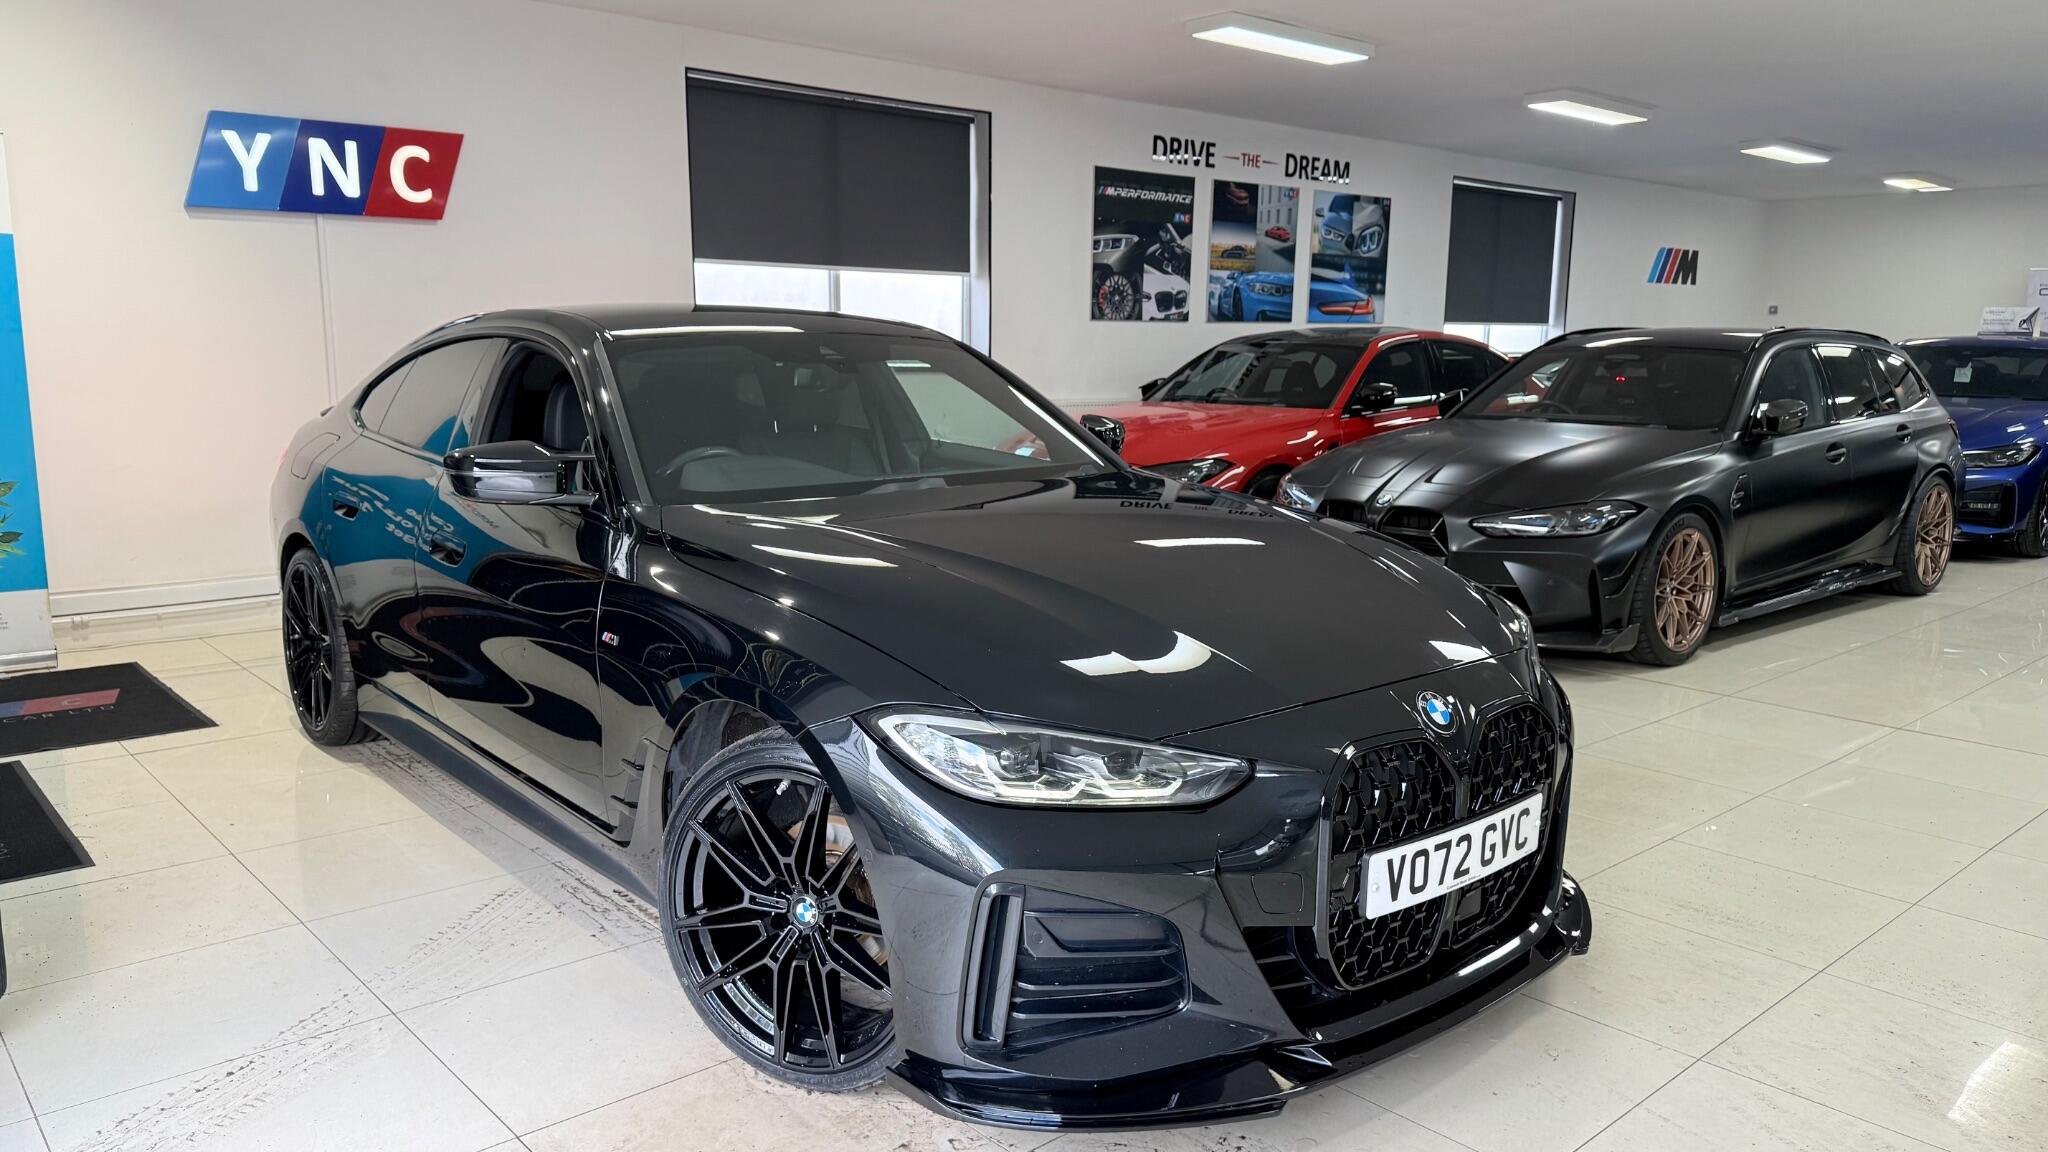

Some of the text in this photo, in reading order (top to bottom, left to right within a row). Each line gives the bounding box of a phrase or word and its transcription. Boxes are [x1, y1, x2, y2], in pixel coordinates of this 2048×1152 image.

[220, 128, 433, 204] YNC
[1152, 134, 1351, 185] DRIVE THE DREAM
[1480, 807, 1531, 868] GVC
